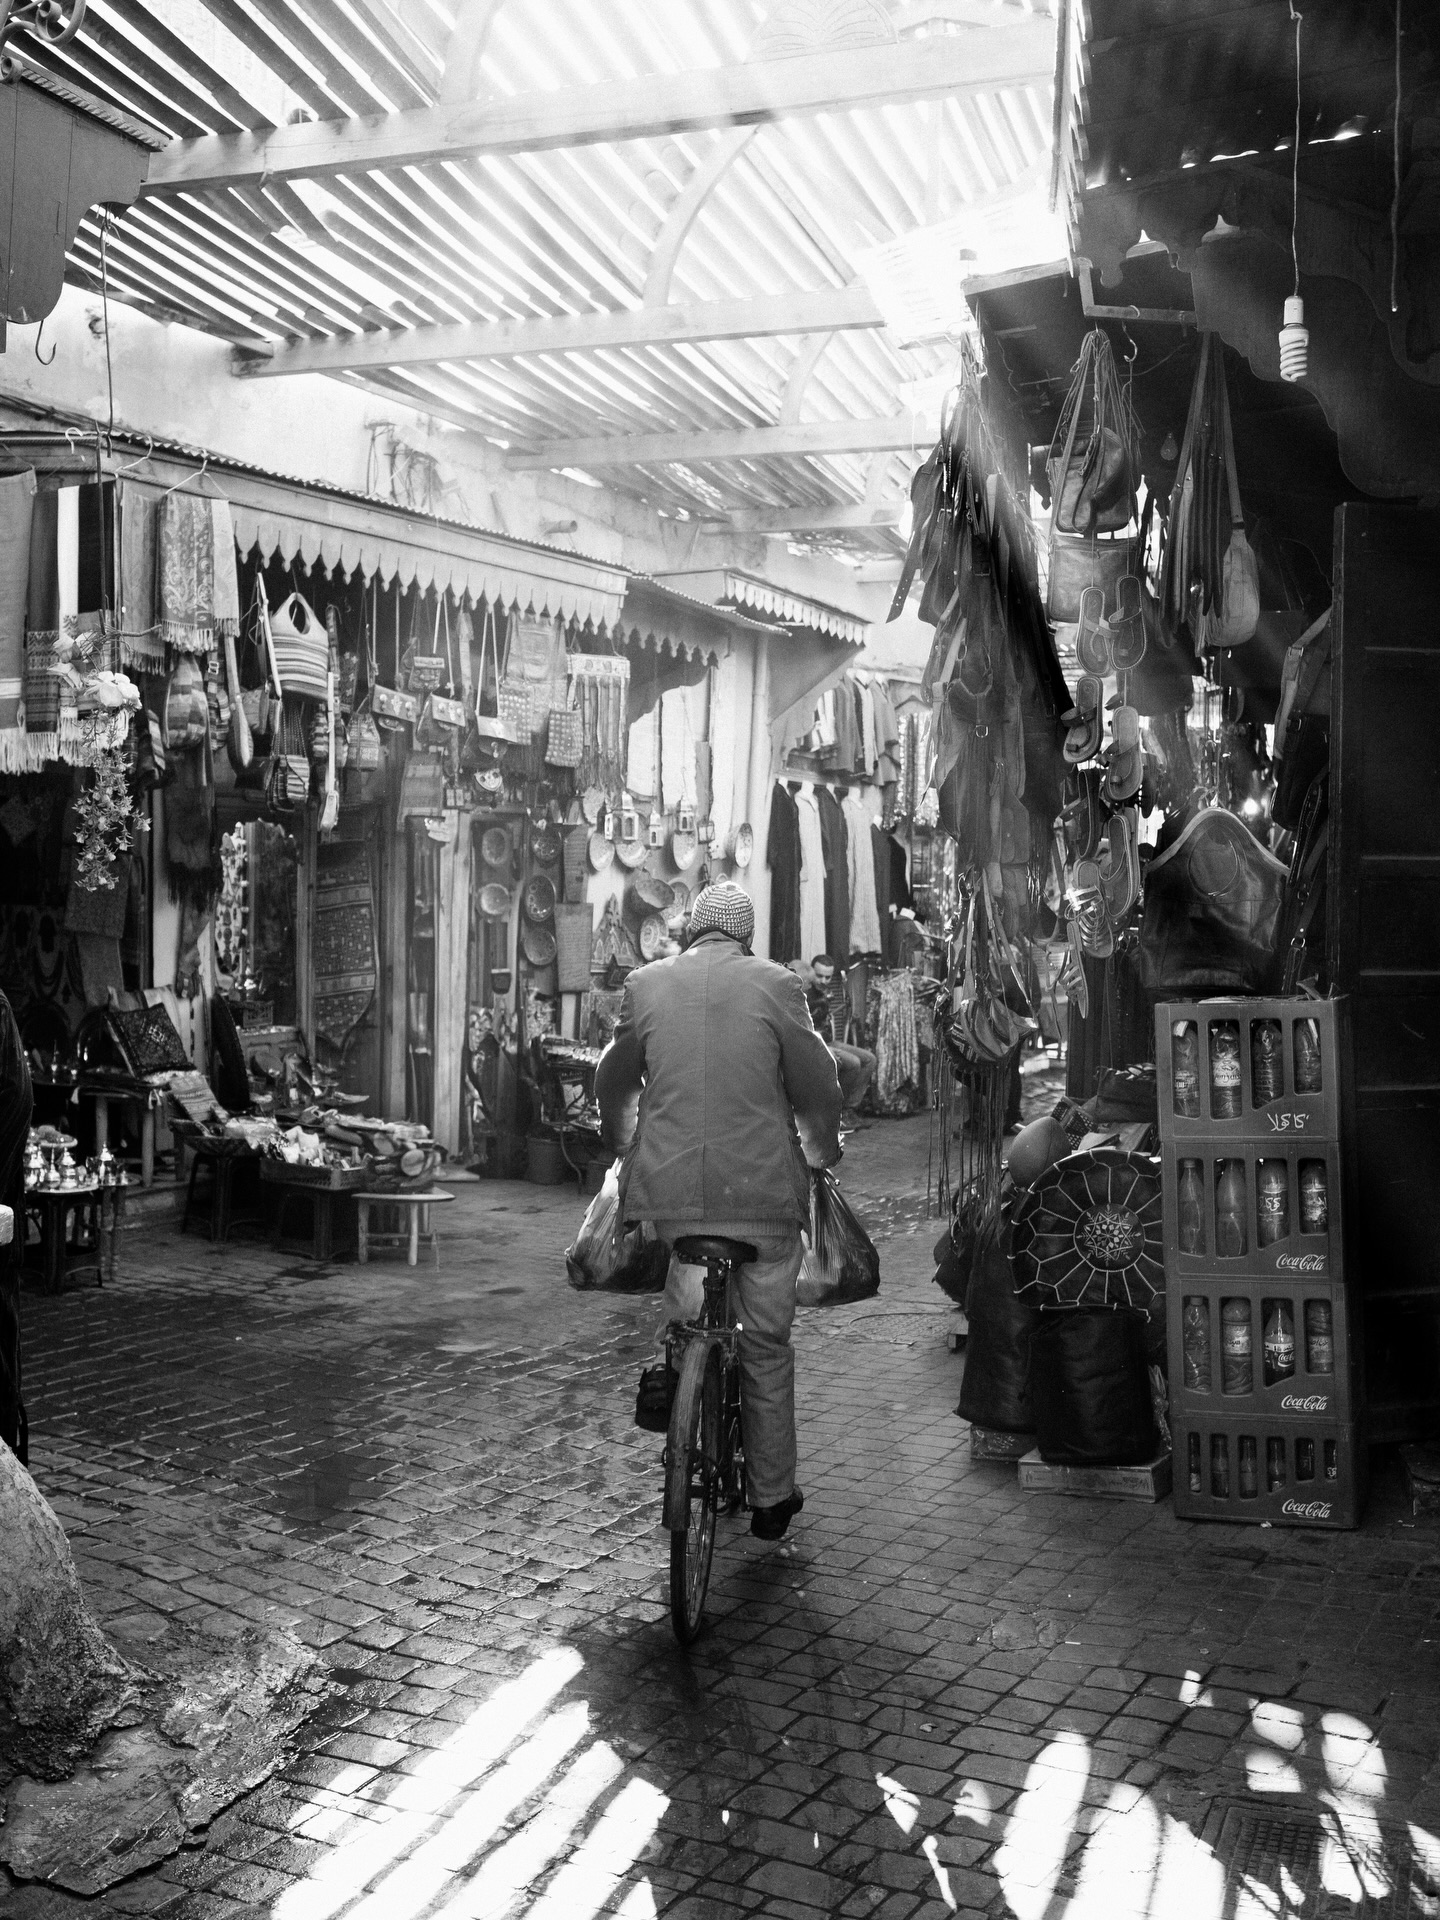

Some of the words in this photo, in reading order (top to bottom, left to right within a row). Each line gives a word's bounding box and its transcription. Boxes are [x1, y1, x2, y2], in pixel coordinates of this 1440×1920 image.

[1276, 1252, 1327, 1271] Coca-Cola
[1281, 1394, 1329, 1411] Coca-Cola
[1282, 1498, 1333, 1518] Coca-Cola
